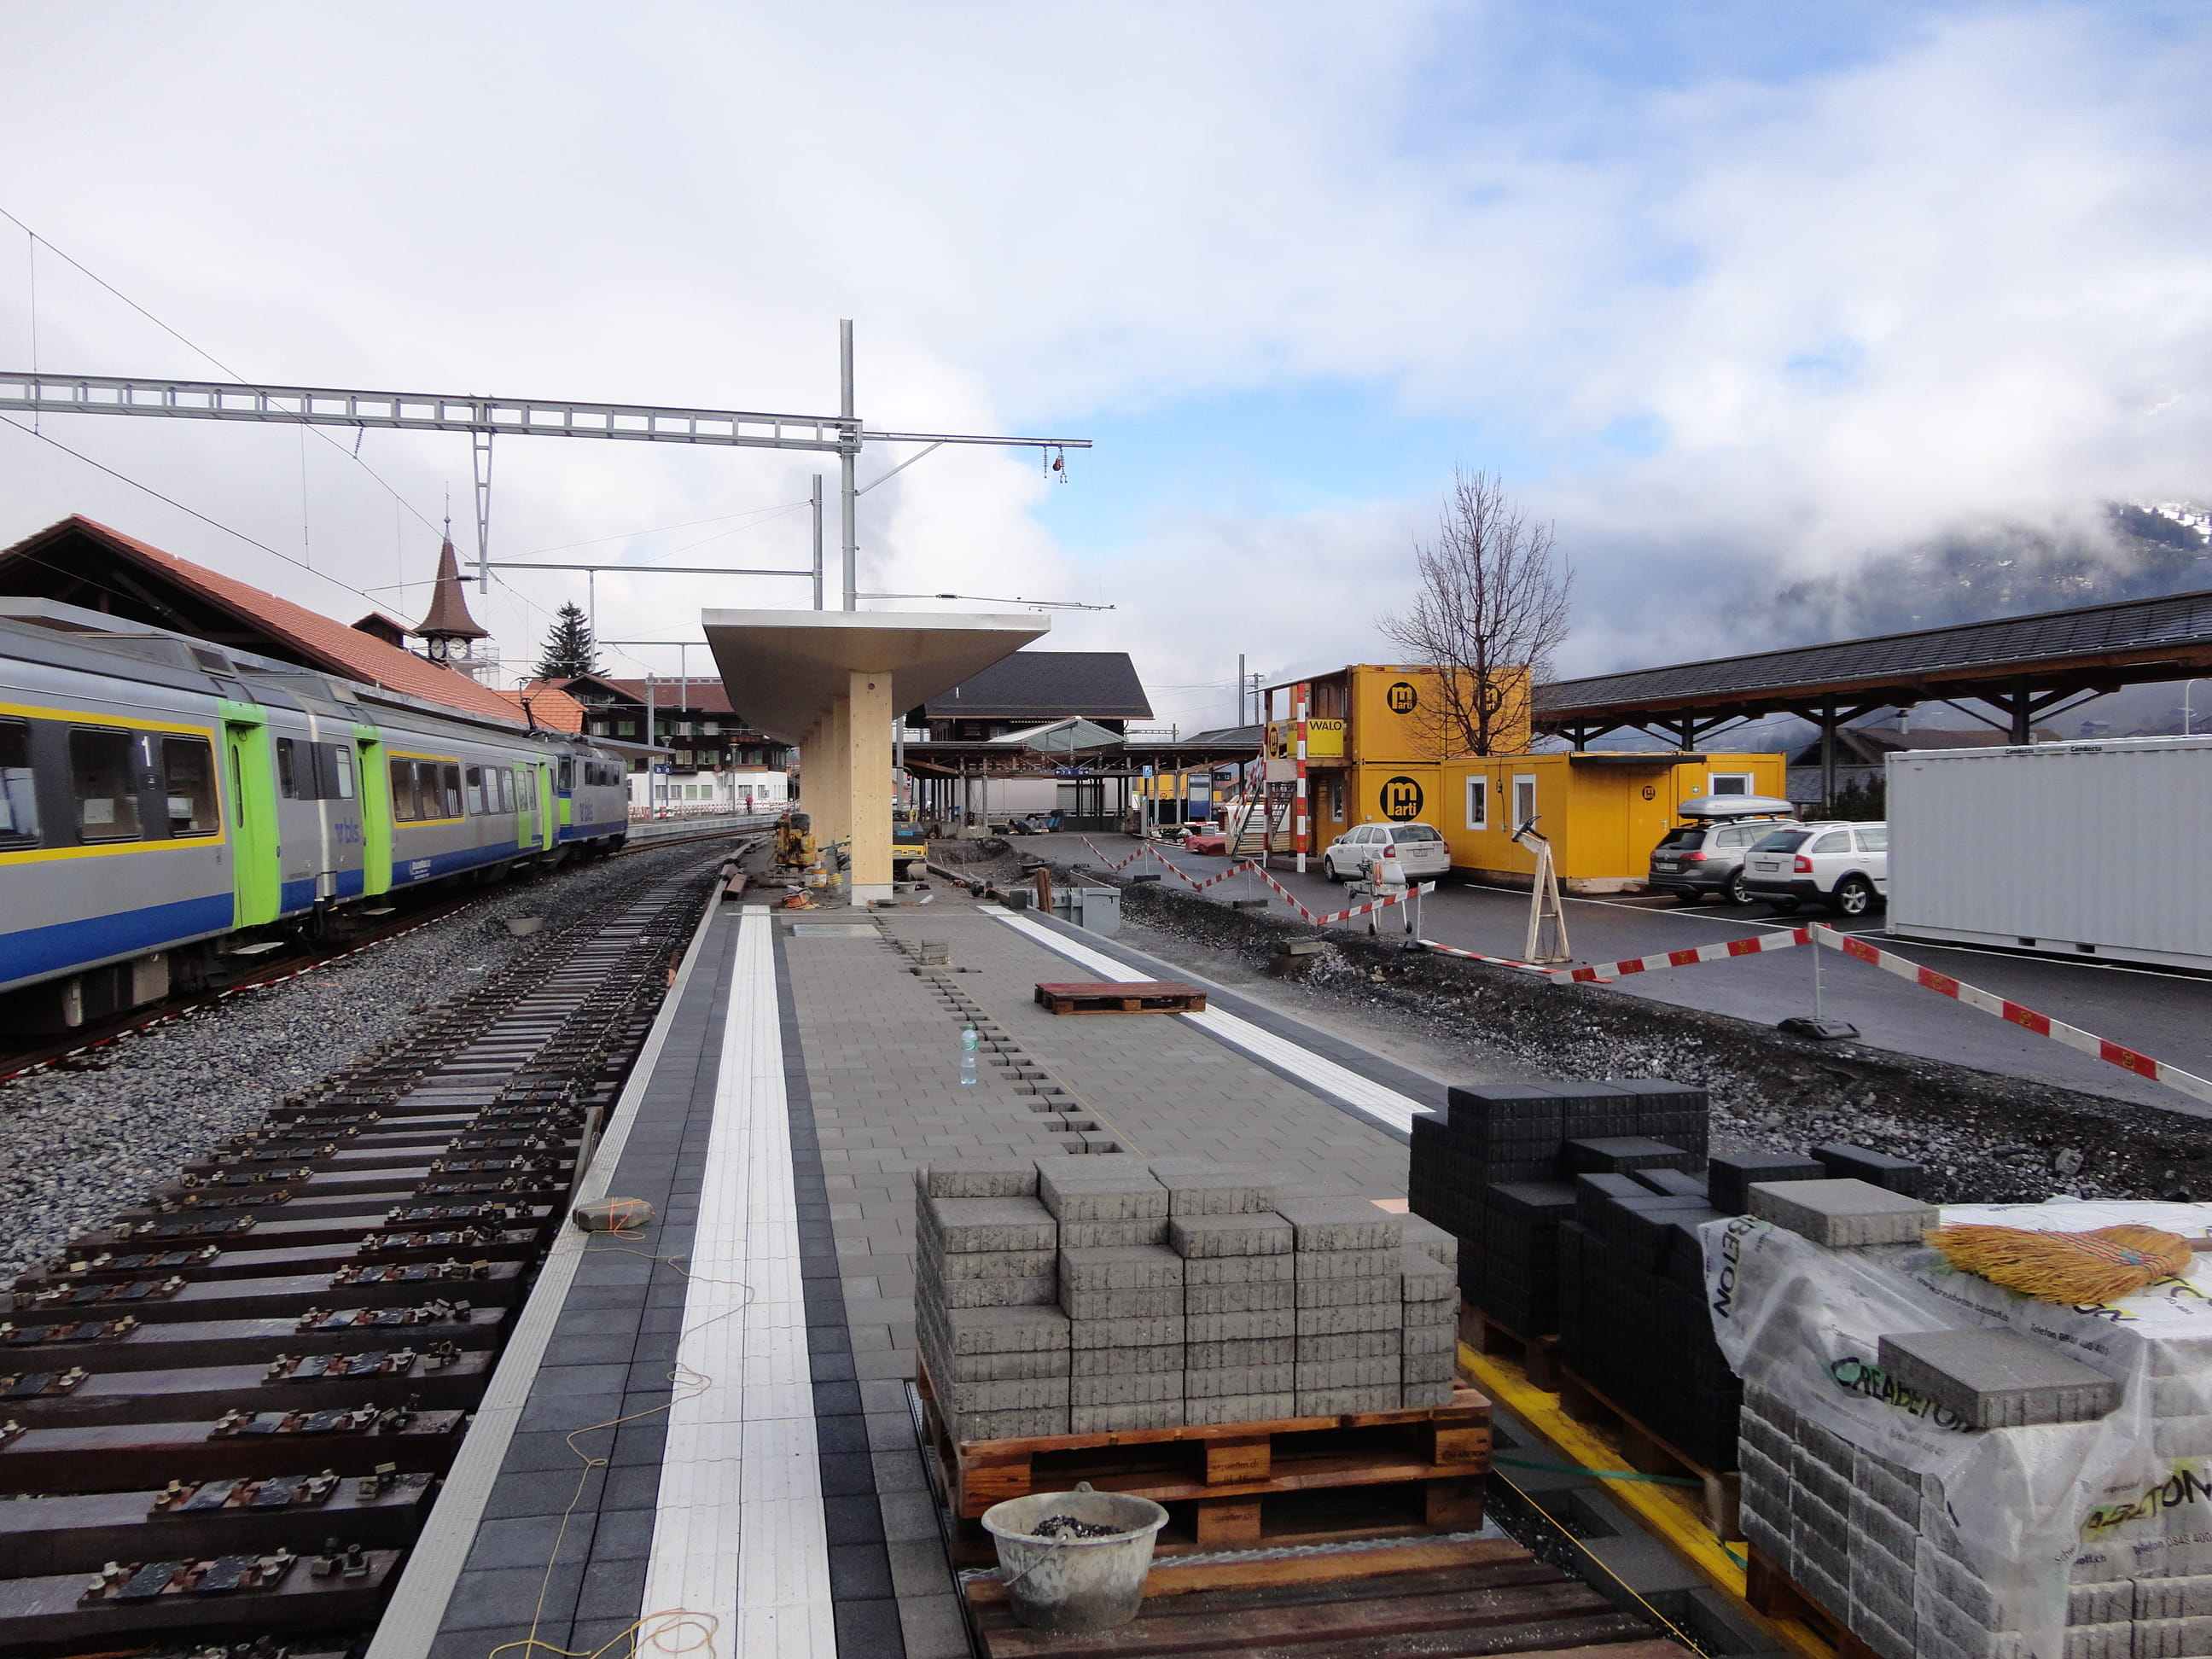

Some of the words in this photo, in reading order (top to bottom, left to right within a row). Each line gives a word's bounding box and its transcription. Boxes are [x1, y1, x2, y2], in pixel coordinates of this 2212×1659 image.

[1393, 686, 1413, 710] marti
[1309, 721, 1342, 731] WALO
[142, 736, 151, 766] 1
[1388, 782, 1417, 817] marti
[344, 817, 359, 844] bls
[2030, 1323, 2057, 1340] Telefon
